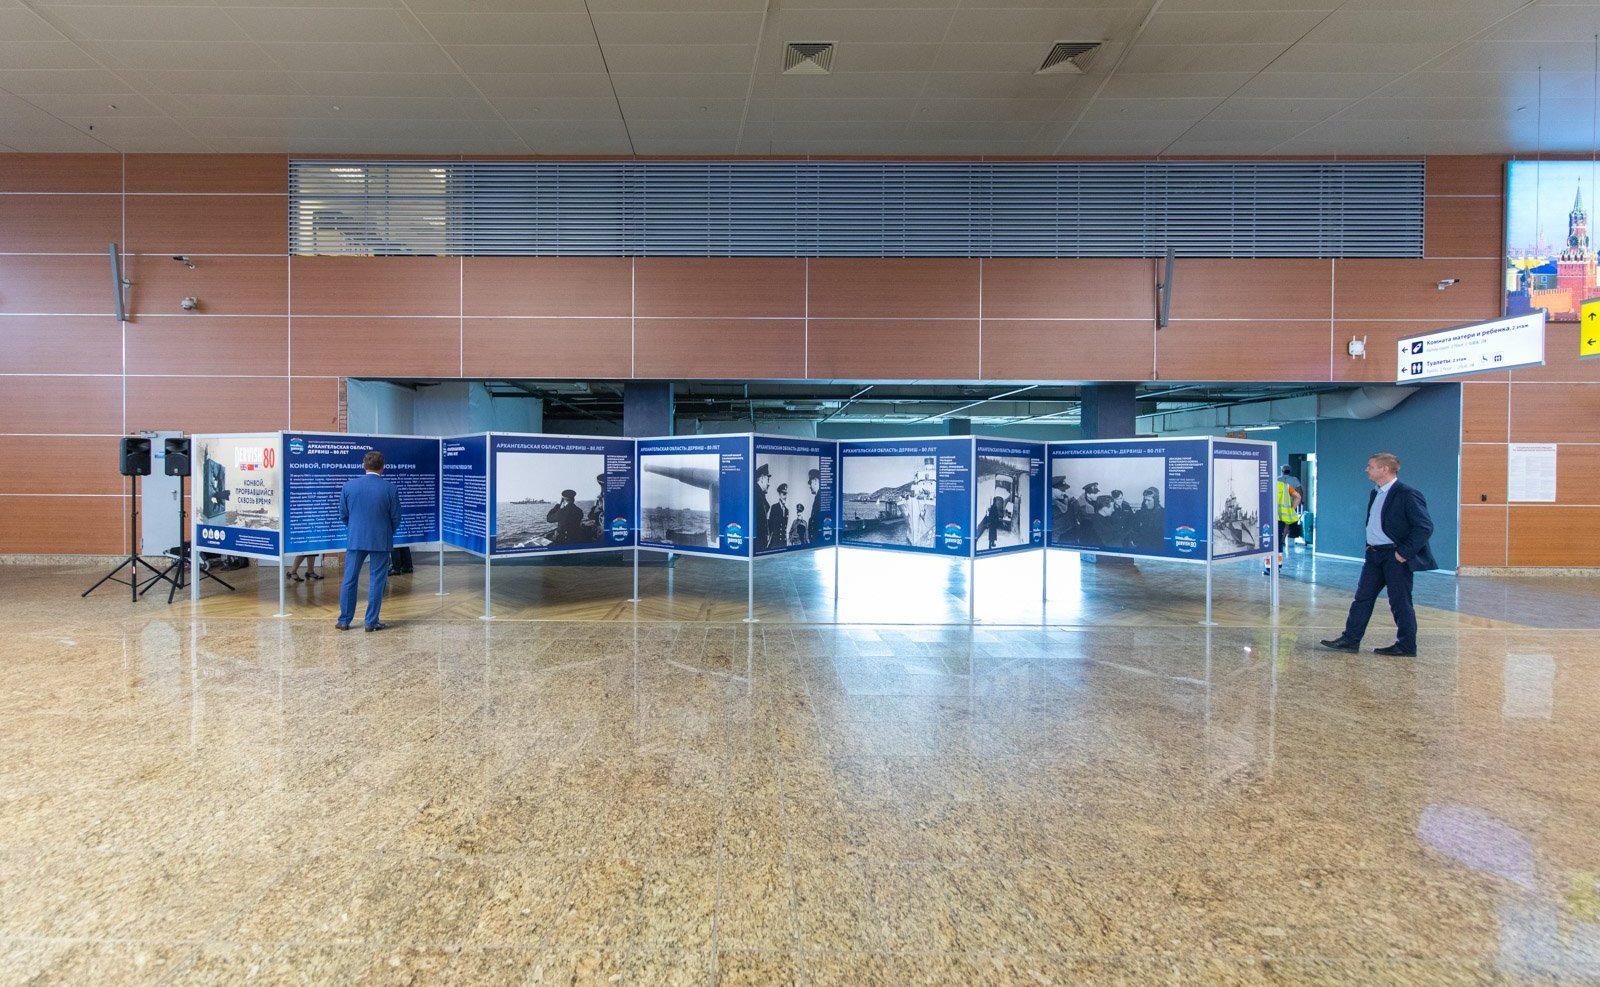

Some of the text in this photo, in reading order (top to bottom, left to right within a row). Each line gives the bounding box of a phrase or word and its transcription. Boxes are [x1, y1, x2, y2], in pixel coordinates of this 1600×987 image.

[1427, 337, 1451, 346] Комната
[1453, 333, 1475, 341] матери
[235, 447, 275, 468] DERVISH 80
[236, 488, 274, 496] ПРОРВАВШИЙСЯ
